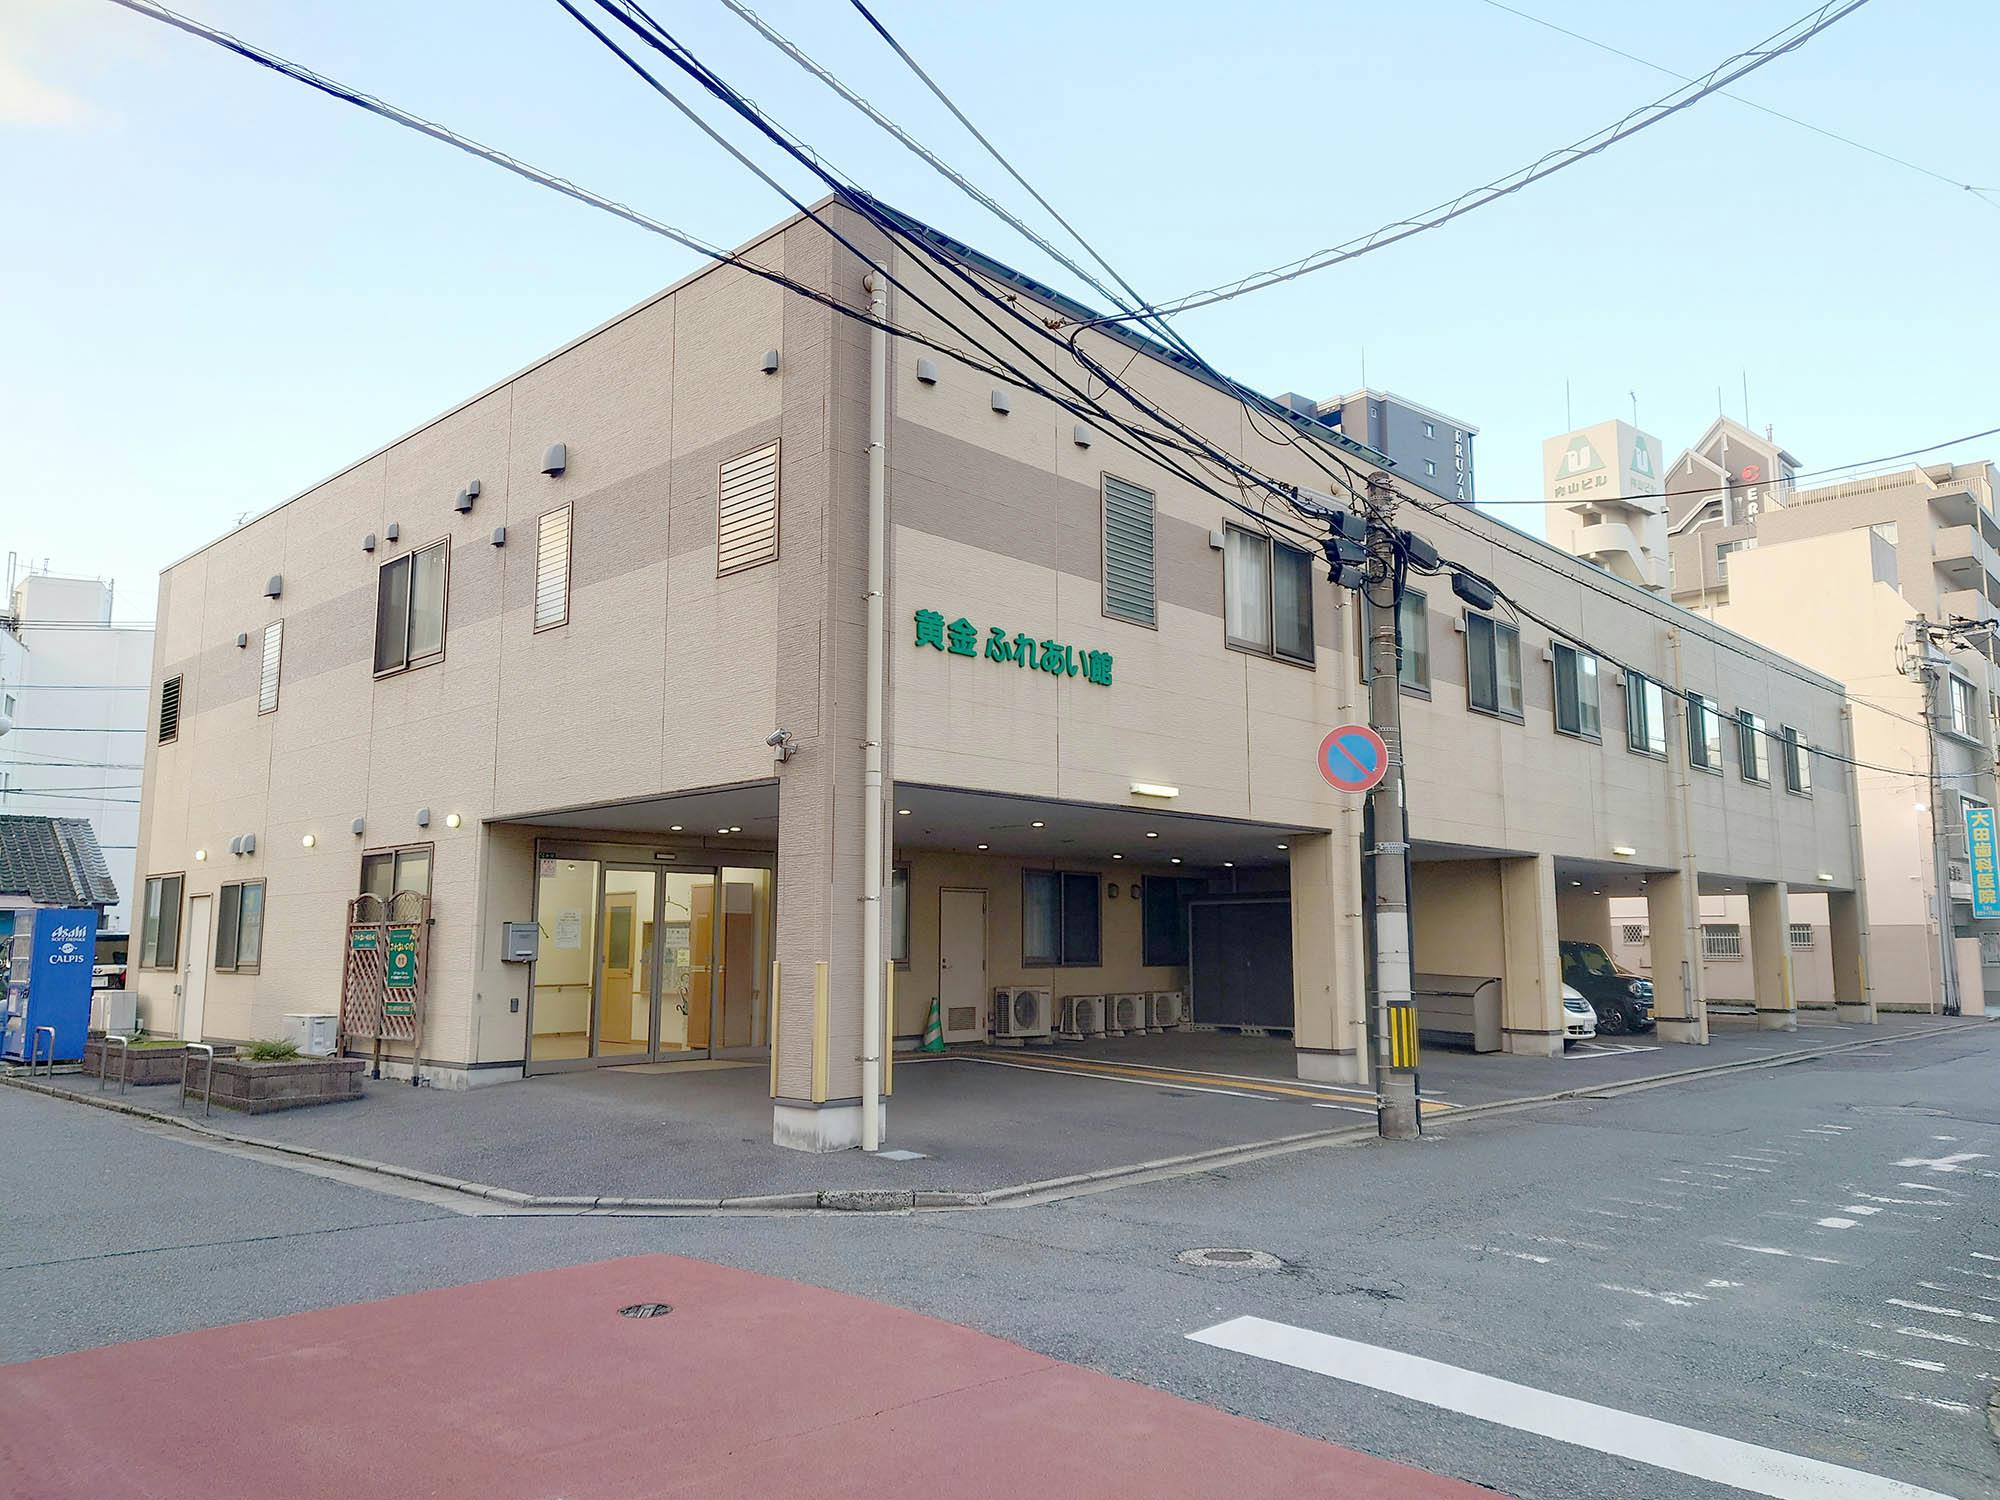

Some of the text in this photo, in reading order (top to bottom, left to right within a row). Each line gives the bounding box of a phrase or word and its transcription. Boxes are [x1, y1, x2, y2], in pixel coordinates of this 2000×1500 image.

[1554, 475, 1607, 498] 内山ビル
[1971, 812, 1996, 904] 大田歯科医院
[51, 925, 87, 938] Asahi
[49, 955, 84, 964] CALPIS
